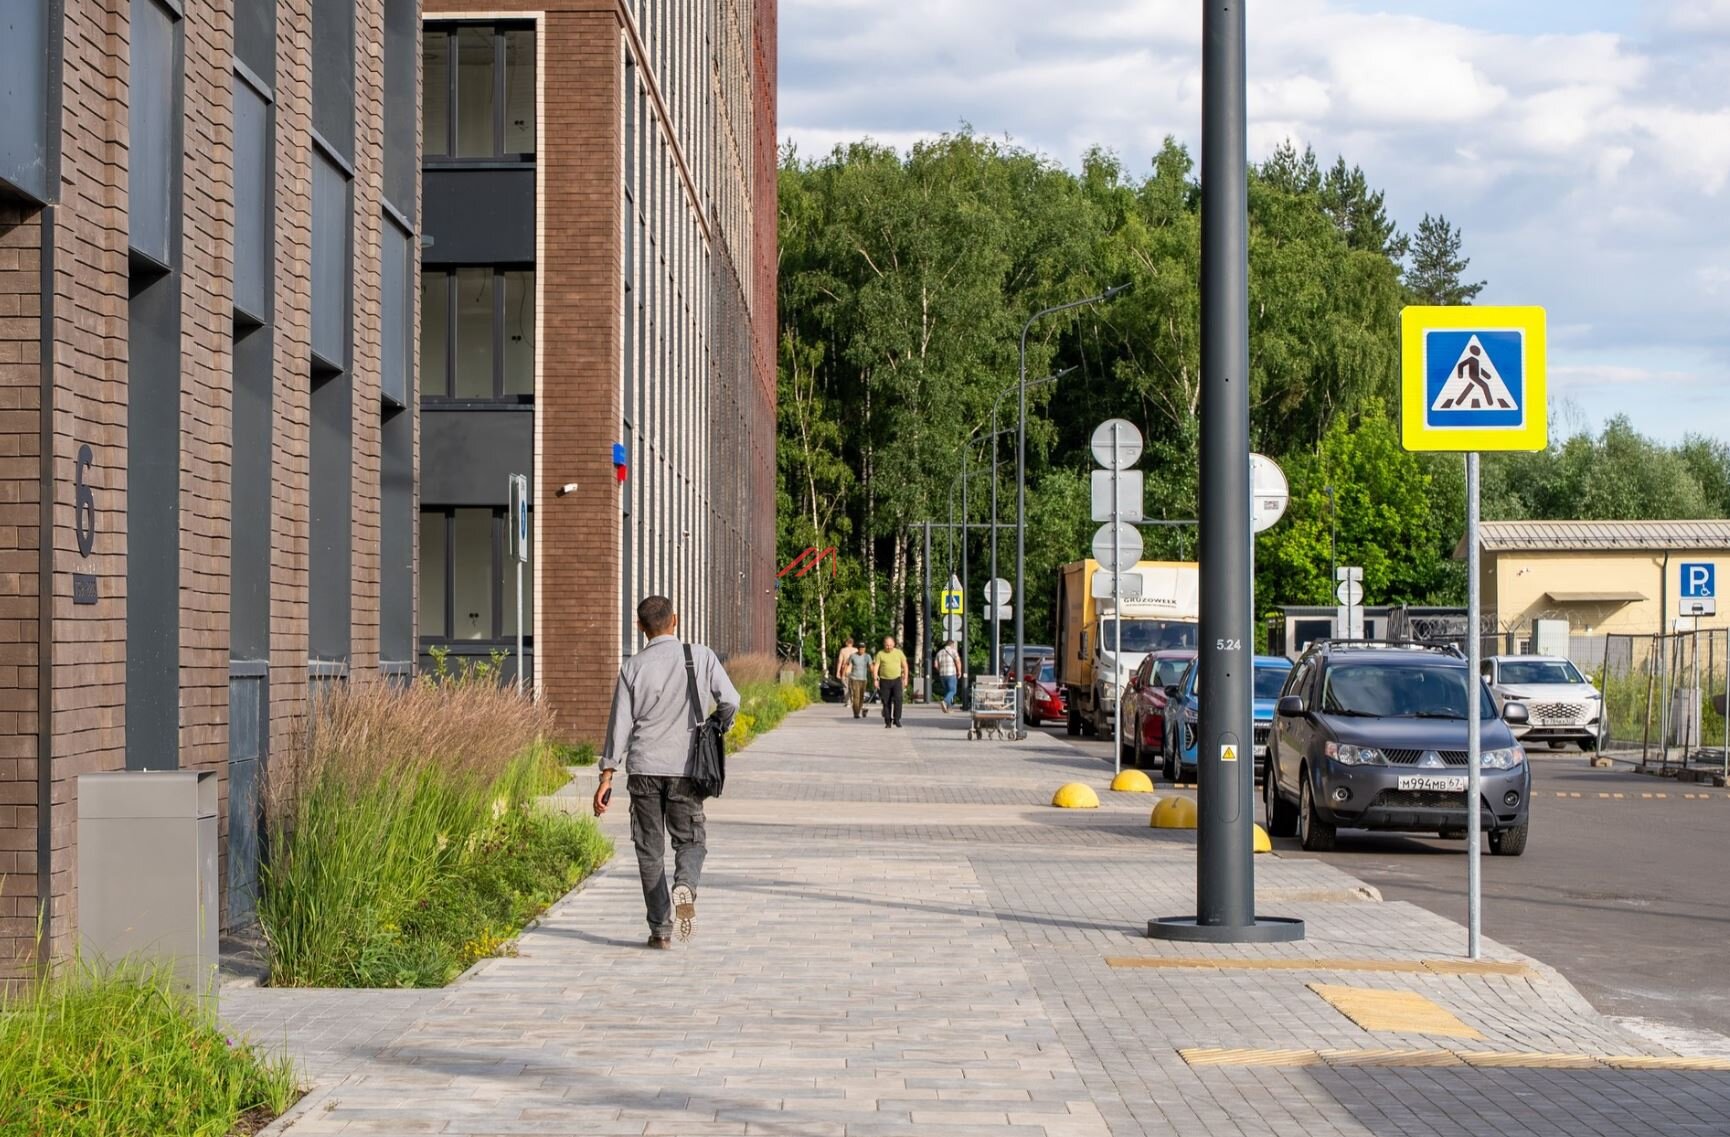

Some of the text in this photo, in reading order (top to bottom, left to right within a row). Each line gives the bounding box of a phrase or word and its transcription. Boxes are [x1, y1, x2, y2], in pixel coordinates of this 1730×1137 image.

[76, 444, 95, 558] 6
[1689, 566, 1709, 595] P
[1216, 639, 1241, 650] 5.24
